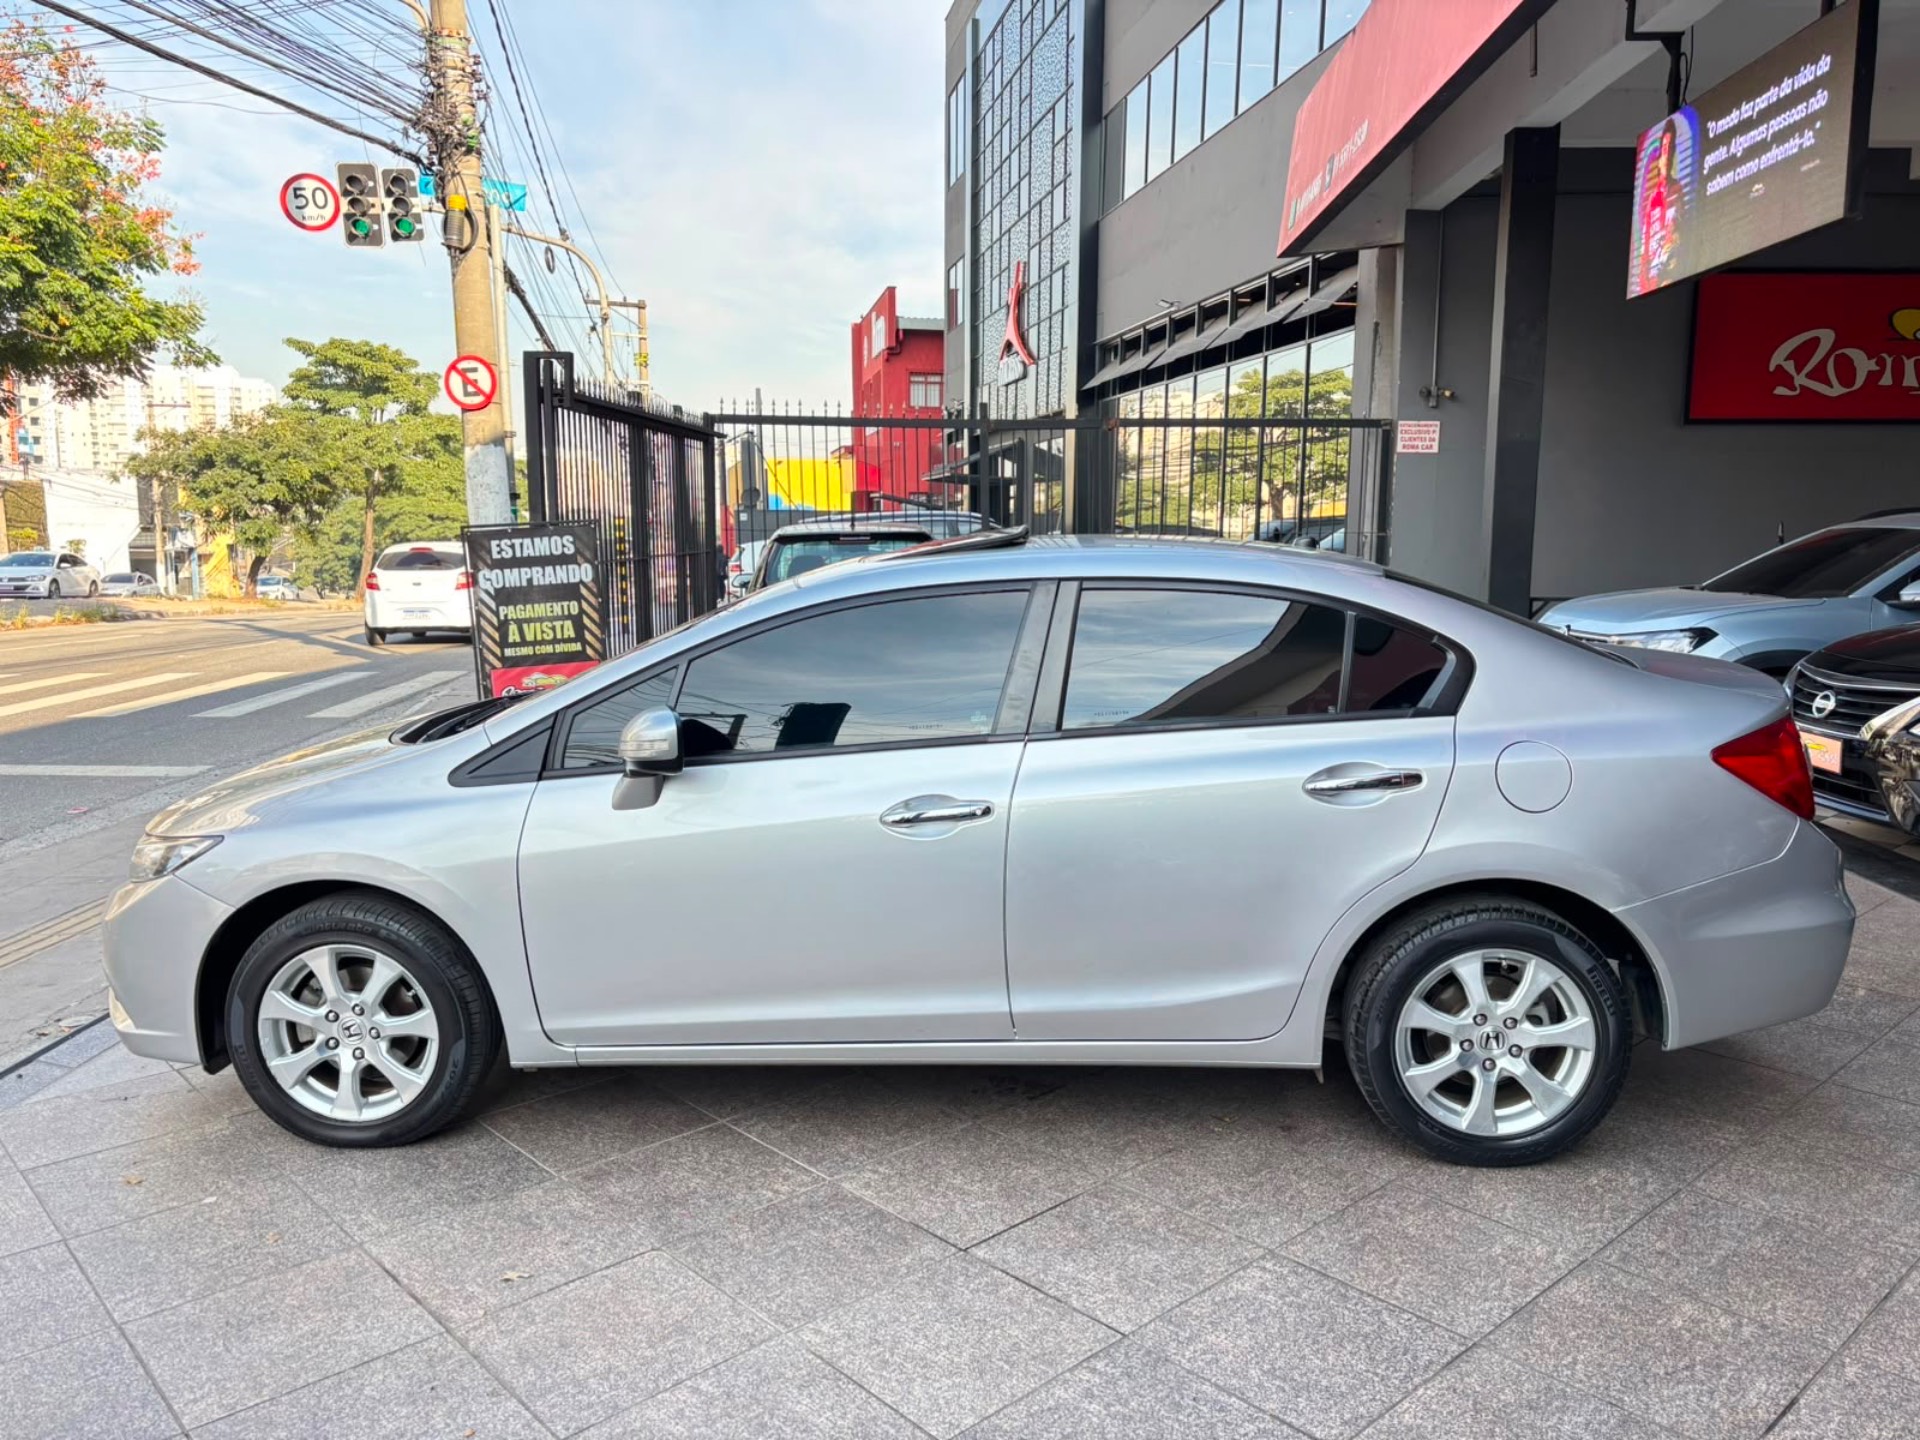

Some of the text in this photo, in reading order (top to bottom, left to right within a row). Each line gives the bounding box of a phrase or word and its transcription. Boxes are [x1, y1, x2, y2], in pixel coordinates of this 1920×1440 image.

[1716, 108, 1740, 135] medo
[1740, 101, 1754, 121] faz
[1752, 86, 1779, 119] parte
[1780, 76, 1793, 98] da
[1793, 63, 1816, 90] vida
[1816, 53, 1831, 77] da
[1729, 123, 1767, 157] Algumas
[1767, 102, 1807, 142] pessoas
[1807, 88, 1829, 114] não
[1706, 170, 1734, 196] sabem
[1735, 158, 1759, 182] como
[292, 187, 329, 210] 50
[460, 366, 480, 398] E
[490, 535, 576, 559] ESTAMOS
[478, 563, 593, 590] COMPRANDO
[499, 600, 579, 620] PAGAMENTO
[508, 620, 576, 643] À VISTA
[504, 642, 582, 657] MESMO COM DÍVIDA
